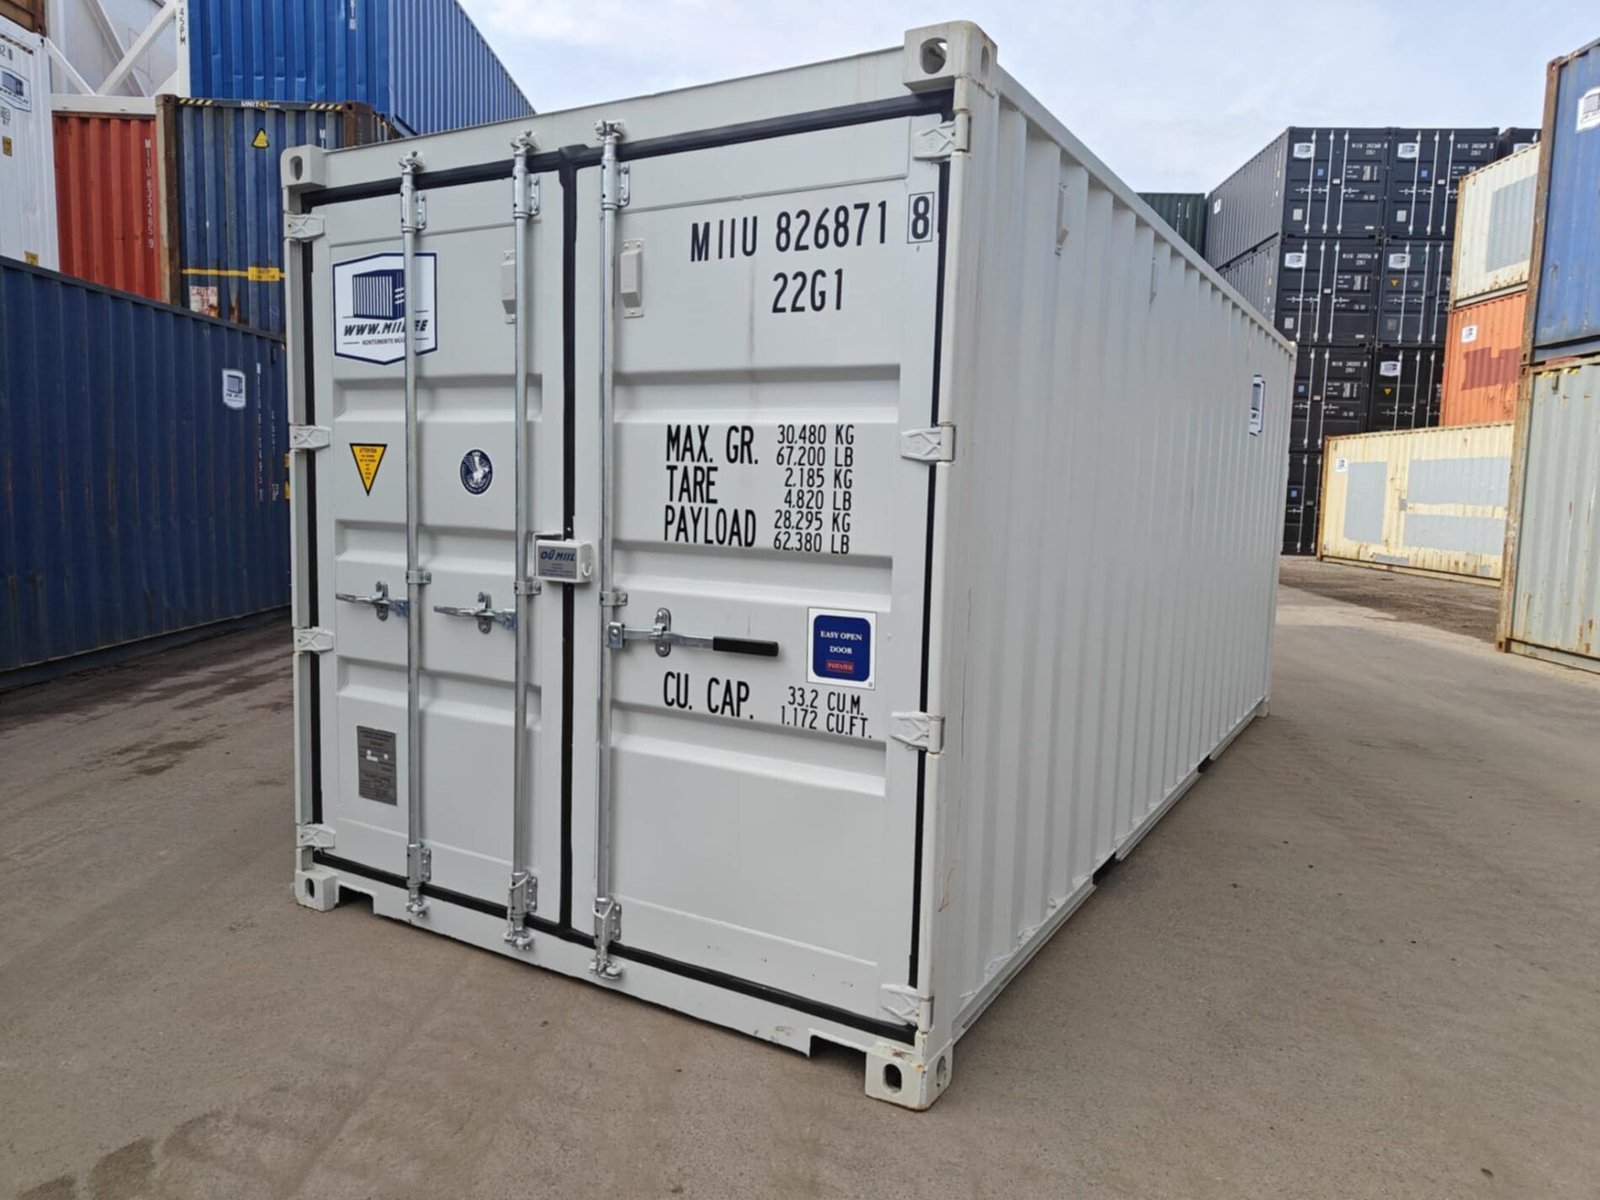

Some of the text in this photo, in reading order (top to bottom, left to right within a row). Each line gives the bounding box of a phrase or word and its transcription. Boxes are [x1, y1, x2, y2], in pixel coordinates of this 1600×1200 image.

[690, 195, 930, 262] MIIU 826871 8
[771, 268, 843, 313] 22G1
[666, 424, 855, 464] MAX. GR. 30.480 KG
[775, 446, 853, 467] 67.200 LB
[666, 465, 853, 504] TARE 2.185 KG
[783, 489, 852, 511] 4.820 LB
[664, 505, 851, 548] PAYLOAD 28.295 KG
[773, 531, 849, 555] 62.380 LB
[820, 630, 862, 641] EASY OPEN
[829, 645, 852, 654] DOOR
[663, 671, 693, 710] CU.
[707, 677, 754, 720] CAP.
[788, 686, 819, 709] 33.2
[781, 705, 818, 730] 1.172
